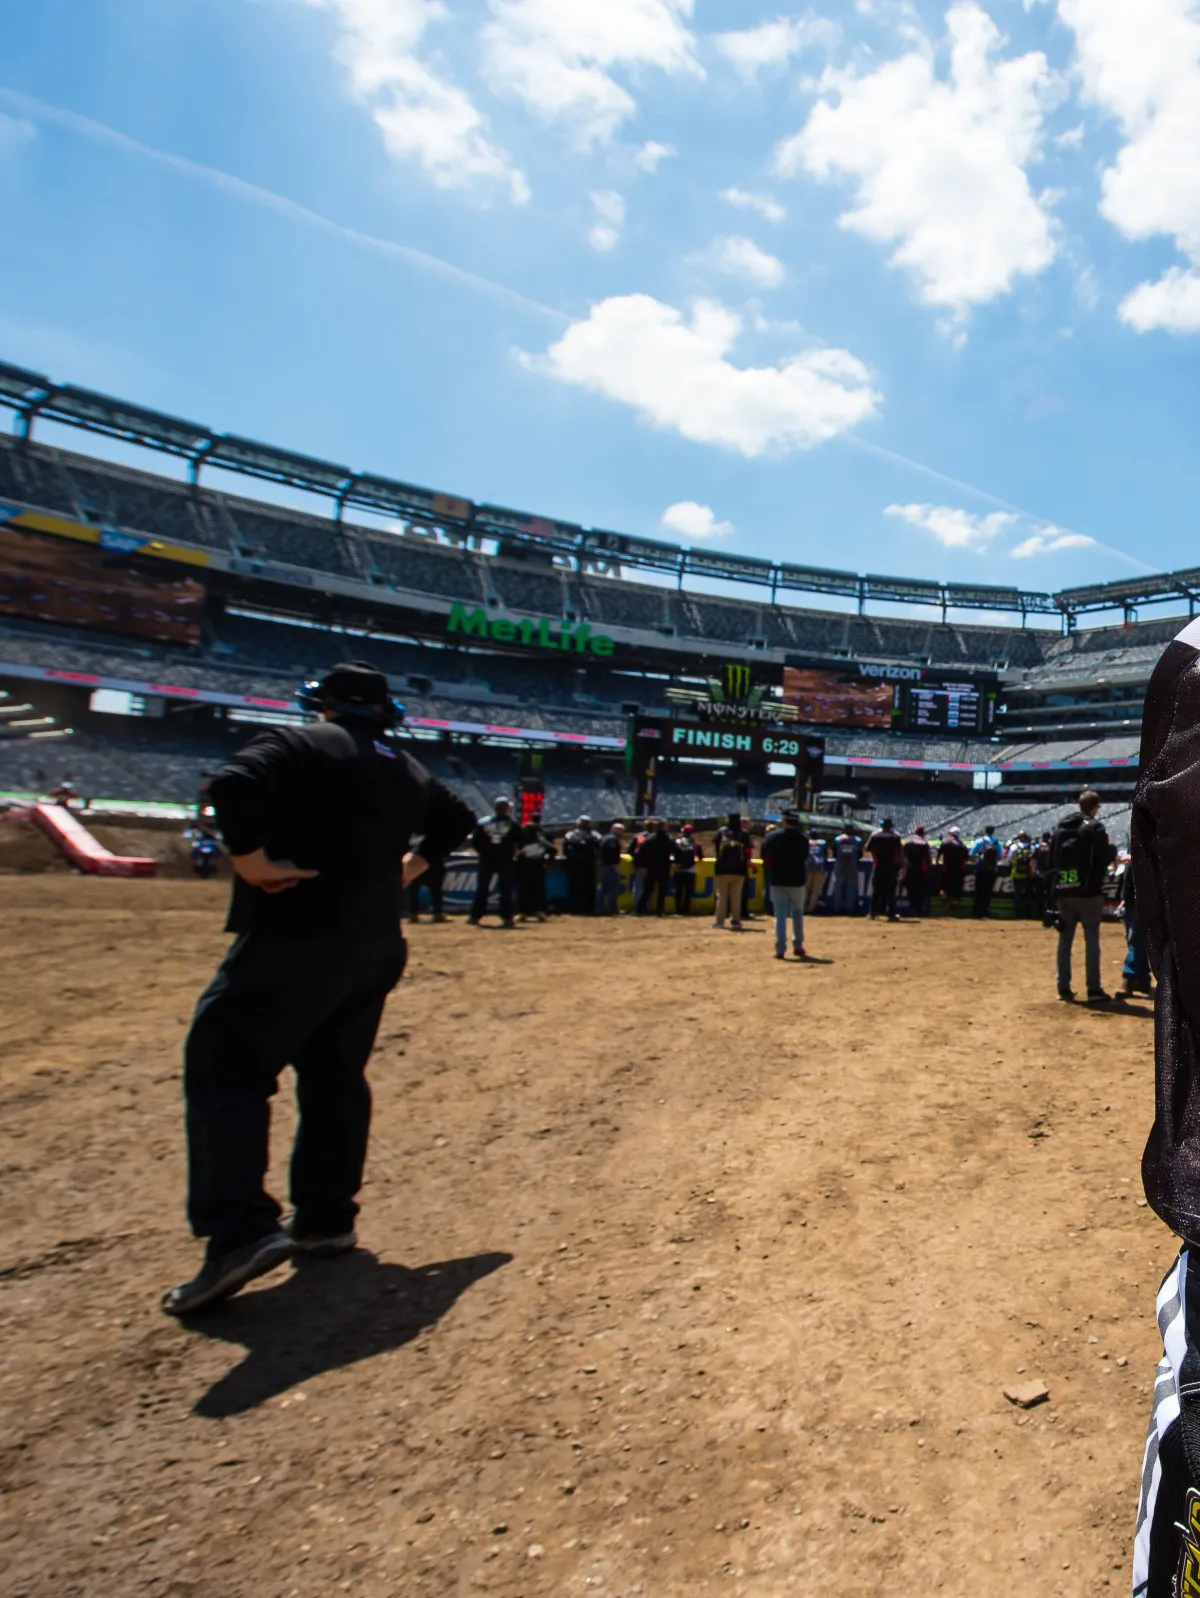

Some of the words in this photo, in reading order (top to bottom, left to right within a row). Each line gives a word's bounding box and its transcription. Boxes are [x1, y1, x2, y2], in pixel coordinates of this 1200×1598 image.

[447, 603, 616, 656] MetLife
[859, 663, 921, 680] verizon
[698, 701, 779, 721] MONSTER
[672, 728, 752, 751] FINISH
[762, 737, 799, 756] 6:29
[1058, 869, 1079, 884] 38
